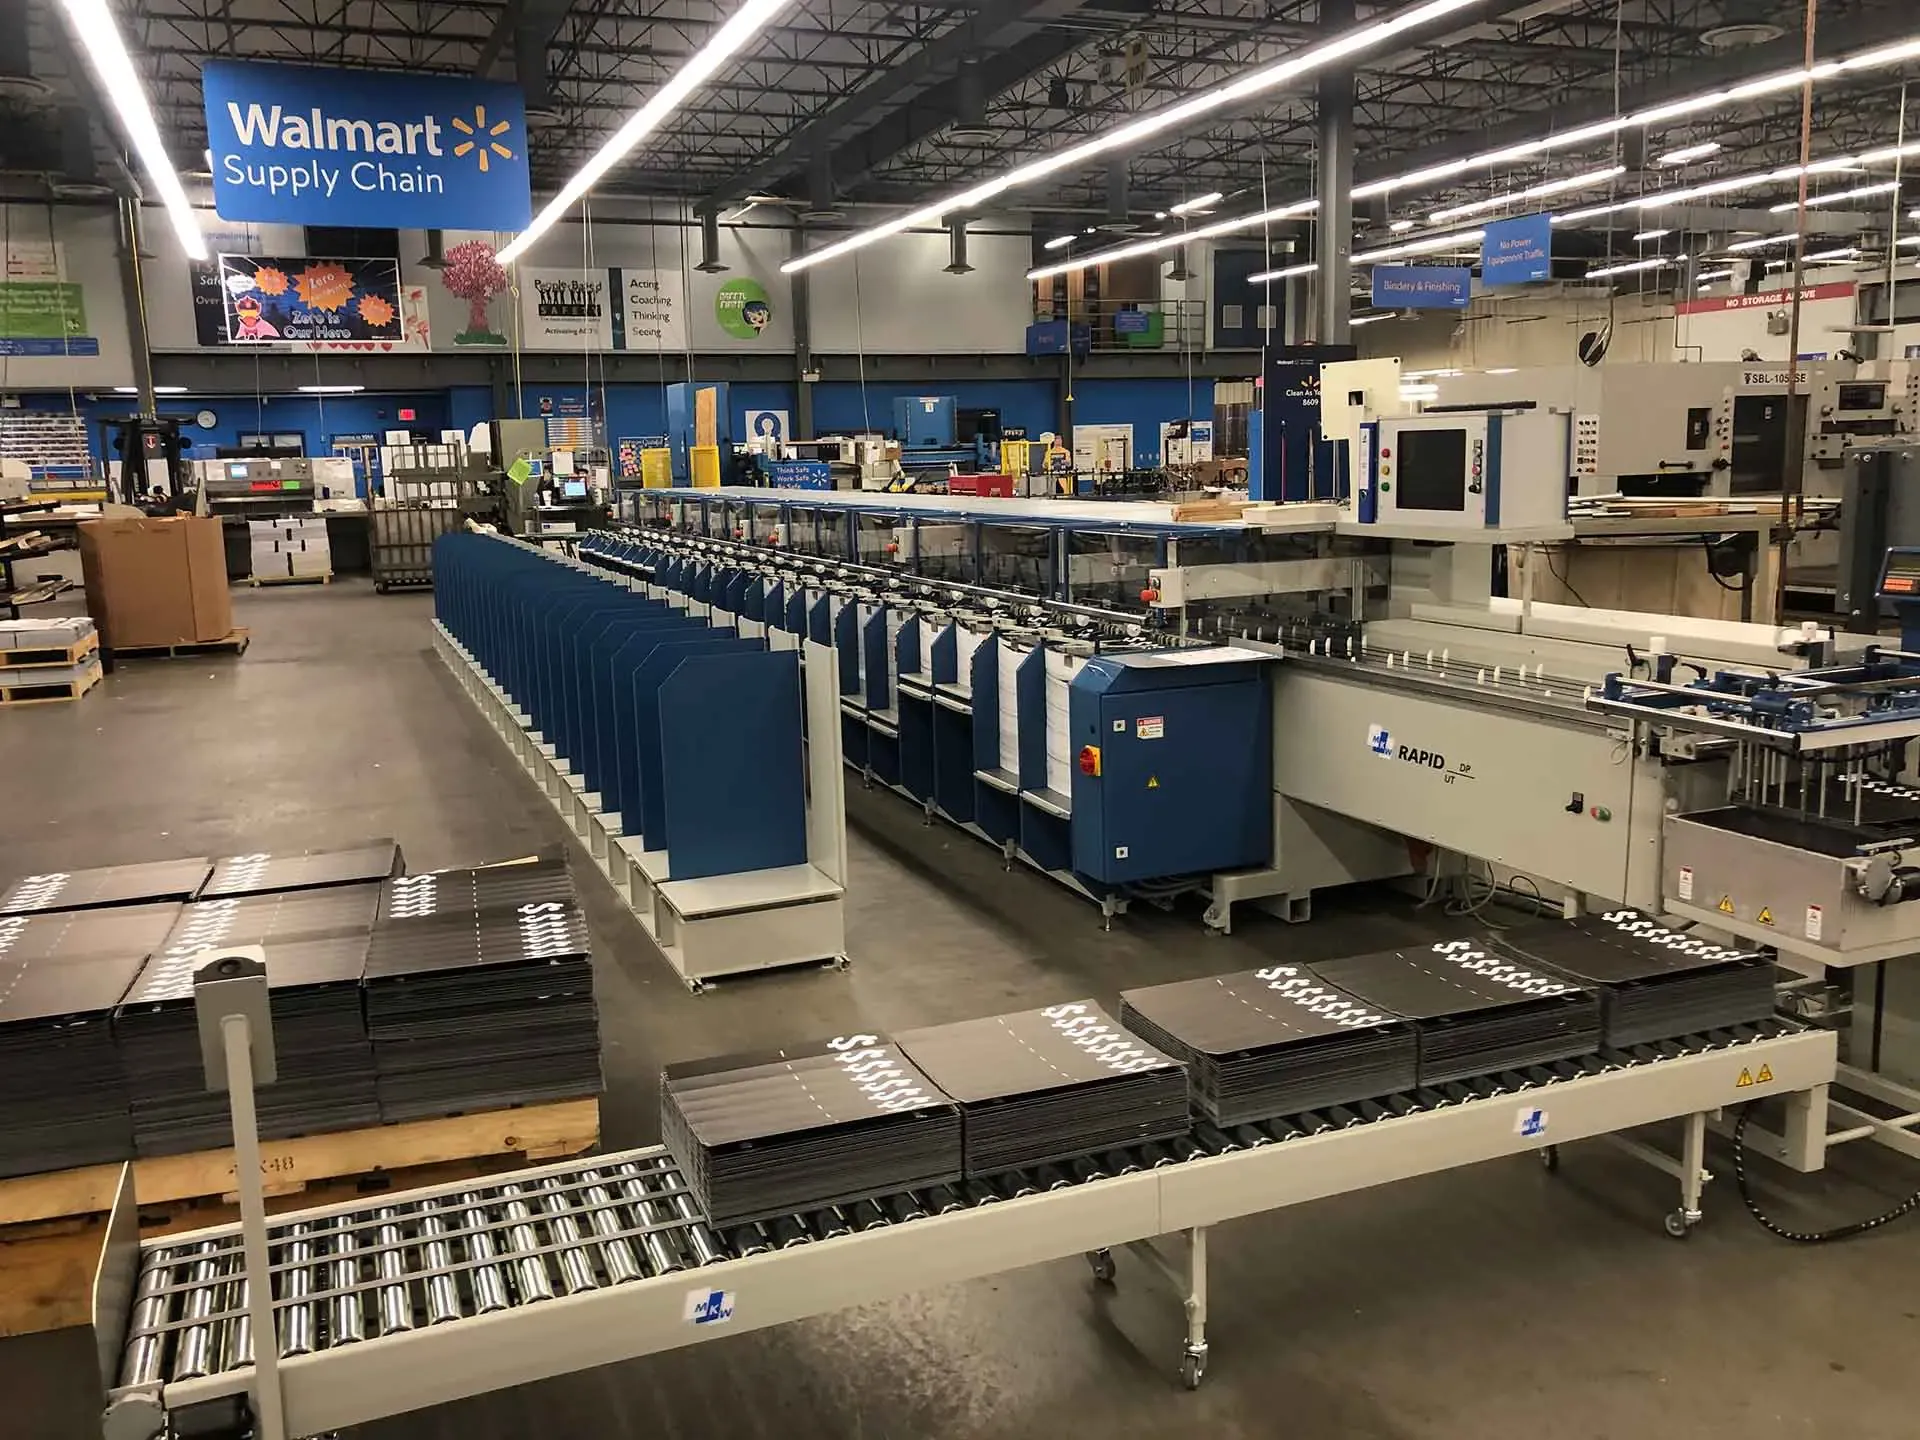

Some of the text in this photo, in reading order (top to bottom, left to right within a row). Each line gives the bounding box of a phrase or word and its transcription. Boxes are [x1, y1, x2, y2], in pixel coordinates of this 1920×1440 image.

[227, 102, 444, 157] Walmart
[223, 154, 444, 198] Supply Chain
[1511, 238, 1533, 249] Power
[630, 279, 660, 290] Acting
[1384, 280, 1461, 295] Bindery & Finishing
[630, 295, 672, 307] Coaching
[1726, 290, 1816, 308] NO STORAGE AOVE
[292, 311, 325, 325] Zero
[632, 311, 670, 323] Thinking
[283, 325, 352, 339] Our Hero
[632, 327, 662, 338] Seeing
[1752, 373, 1807, 384] SBL-105SE
[1286, 389, 1304, 397] Clean
[1302, 398, 1319, 406] 8609
[1398, 745, 1445, 770] RAPID
[1444, 774, 1456, 784] UT
